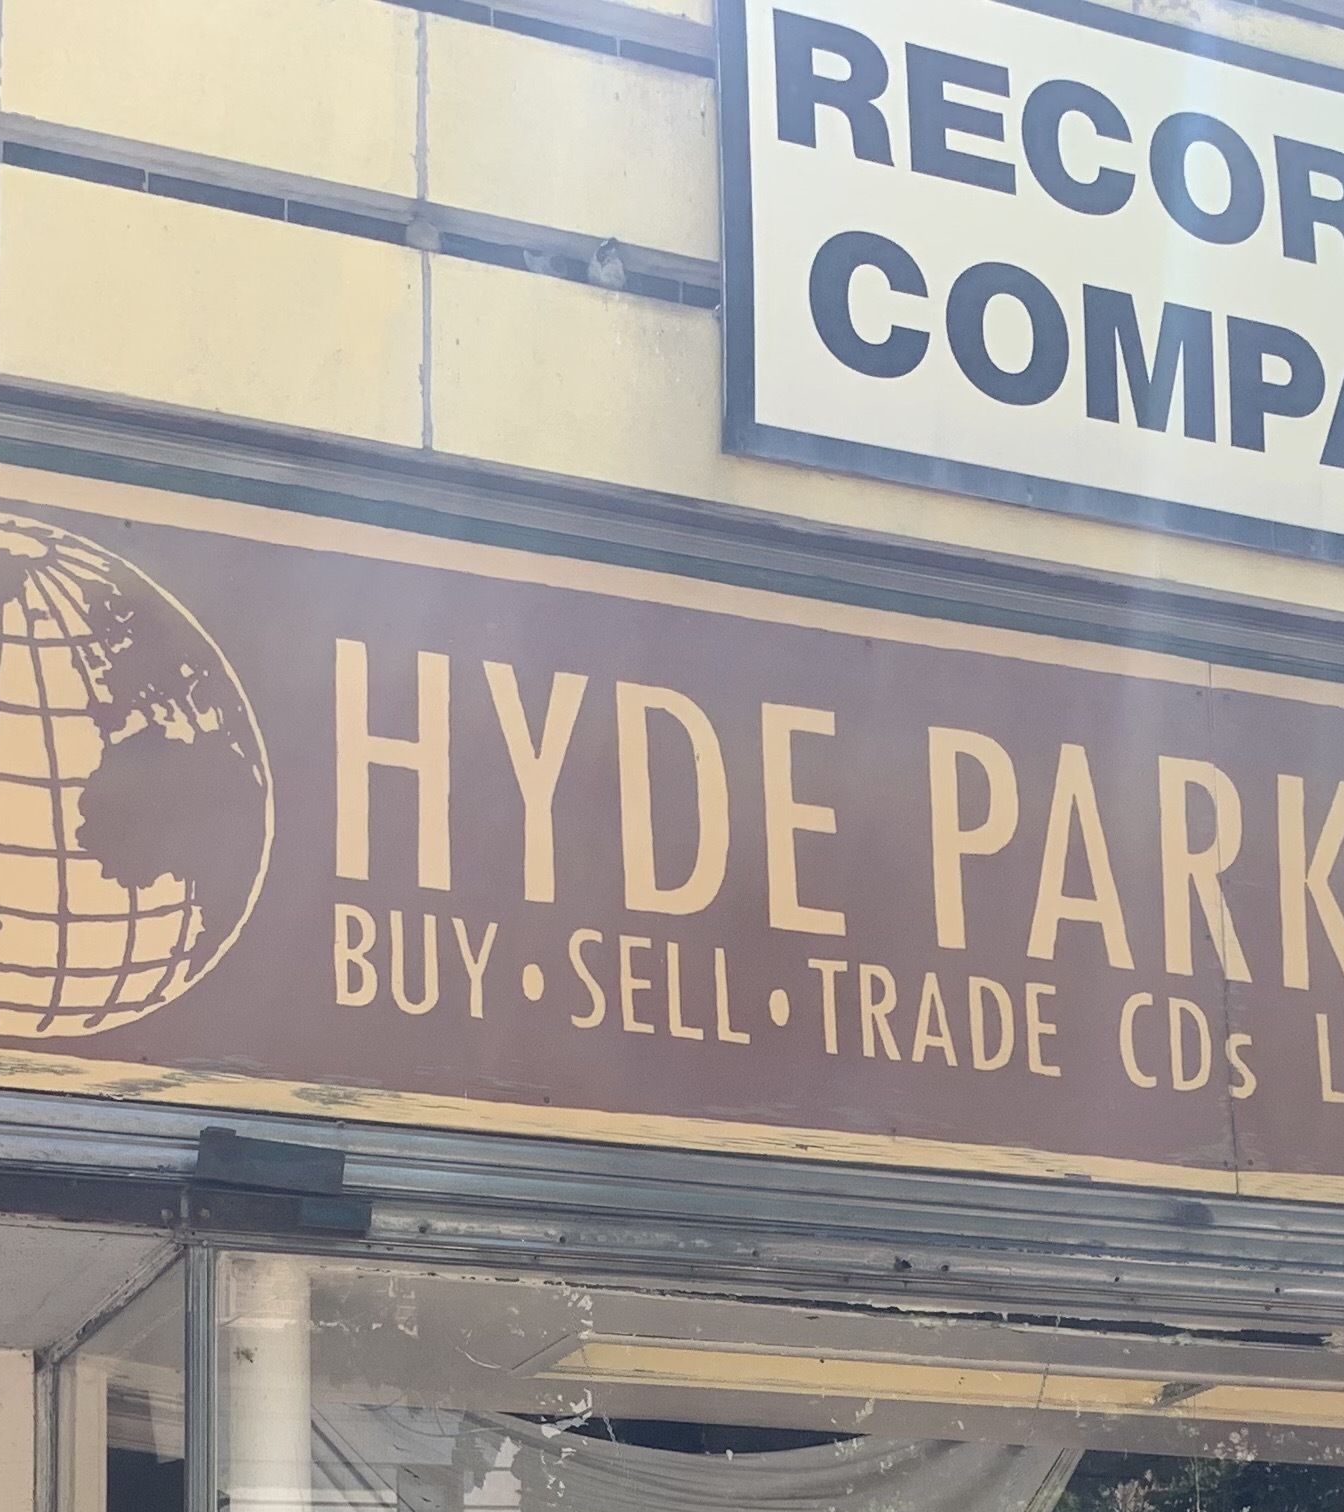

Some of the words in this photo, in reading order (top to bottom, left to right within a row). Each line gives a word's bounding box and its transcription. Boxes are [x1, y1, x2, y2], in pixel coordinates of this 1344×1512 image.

[333, 637, 847, 938] HYDE
[333, 903, 499, 1020] BUY
[567, 927, 751, 1046] SELL
[806, 957, 1063, 1079] TRADE
[1118, 991, 1257, 1100] CDs
